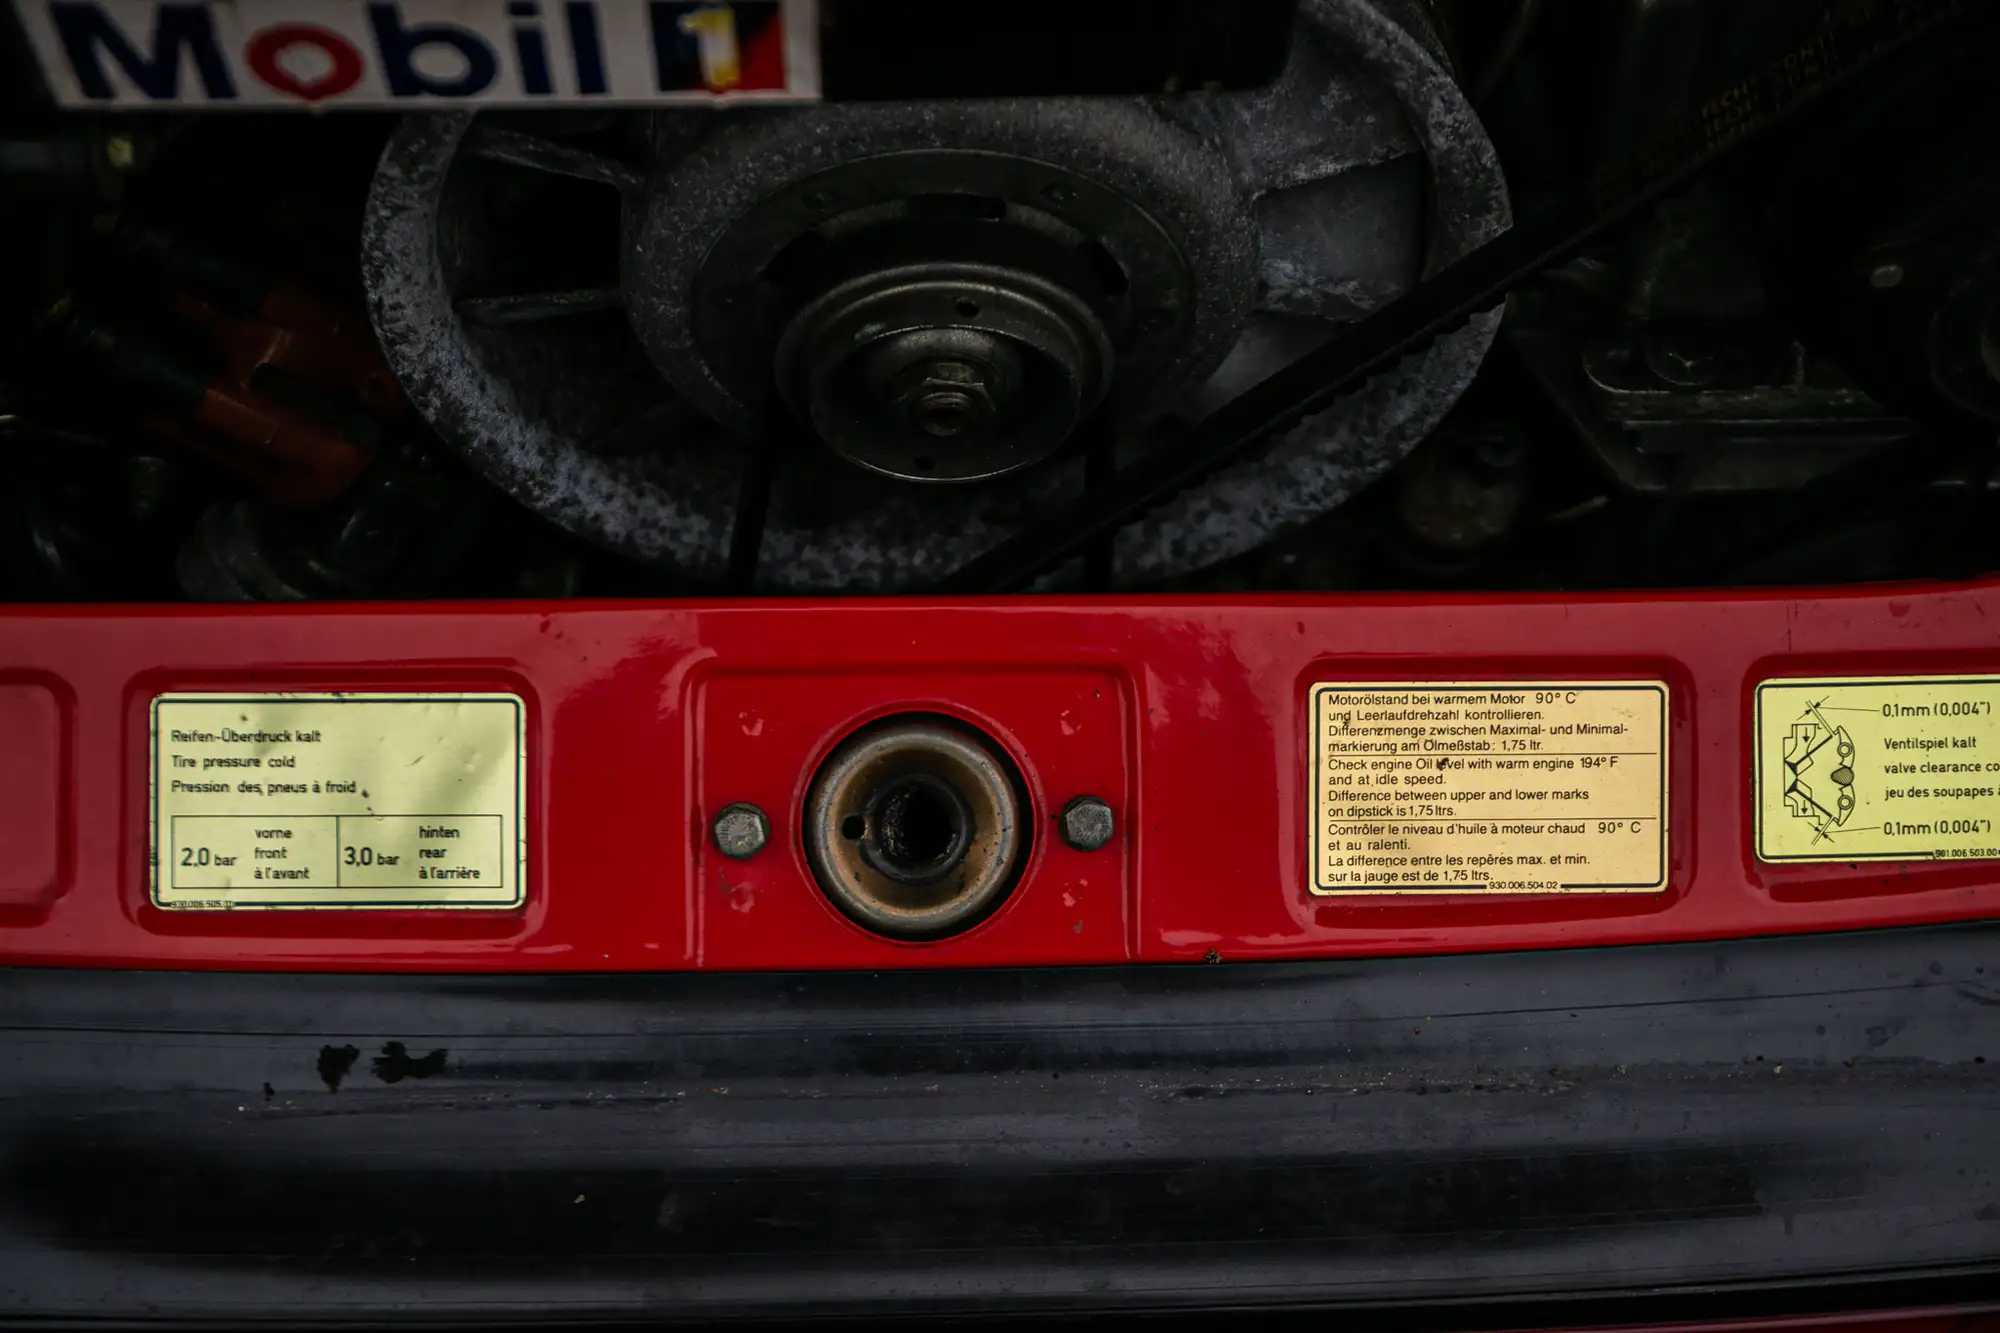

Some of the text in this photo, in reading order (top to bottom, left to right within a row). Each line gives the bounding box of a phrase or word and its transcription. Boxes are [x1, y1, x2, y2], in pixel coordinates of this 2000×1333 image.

[49, 1, 741, 101] Mobil 1
[1328, 692, 1576, 705] Motorölstand bei warmem Motor 90° C
[1329, 709, 1543, 723] und Leerlaufdrehzahl kontrollieren.
[172, 728, 321, 743] Reifen-Überdruck kalt
[1329, 723, 1628, 737] Differenzmenge zwischen Maximal- und Minimal-
[1329, 742, 1397, 754] markierung
[1402, 741, 1421, 751] am
[1501, 740, 1526, 752] 1,75
[1529, 740, 1544, 750] ltr.
[1884, 737, 1976, 751] Ventilspiel kalt
[172, 755, 295, 770] Tire pressure cold
[1328, 759, 1367, 770] Check
[1371, 760, 1412, 772] engine
[1415, 758, 1432, 769] Oil
[1468, 759, 1492, 769] with
[1496, 761, 1529, 769] warm
[1533, 758, 1574, 771] engine
[1610, 756, 1618, 767] F
[1884, 763, 1916, 773] valve
[1920, 762, 1981, 773] clearance
[1329, 774, 1352, 785] and
[1376, 774, 1398, 784] idle
[1404, 774, 1446, 786] speed.
[172, 780, 229, 792] Pression
[268, 784, 307, 796] pneus
[312, 781, 320, 793] à
[326, 781, 356, 793] froid
[1885, 787, 1904, 801] jeu
[1908, 787, 1929, 797] des
[1934, 788, 1993, 799] soupapes
[1329, 789, 1589, 803] Difference between upper and lower marks
[1328, 805, 1456, 818] on dipstick is 1,75 ltrs.
[255, 830, 292, 838] vorne
[419, 826, 459, 838] hinten
[1329, 821, 1641, 835] Contrôler le niveau d'huile à moteur chaud 90° C
[1328, 839, 1410, 851] et au ralenti.
[255, 847, 287, 858] front
[345, 846, 400, 866] 3,0 bar
[419, 849, 446, 858] rear
[215, 854, 236, 866] bar
[1329, 856, 1343, 866] La
[1347, 855, 1407, 867] difference
[1411, 856, 1442, 866] entre
[1446, 855, 1463, 865] les
[1517, 856, 1545, 865] max.
[1550, 855, 1561, 864] et
[1565, 854, 1590, 864] min.
[255, 868, 263, 879] à
[419, 867, 428, 879] à
[1329, 874, 1347, 882] sur
[1351, 871, 1361, 881] la
[1364, 871, 1398, 884] jauge
[1402, 871, 1420, 881] est
[1424, 870, 1438, 881] de
[1472, 870, 1493, 881] ltrs.
